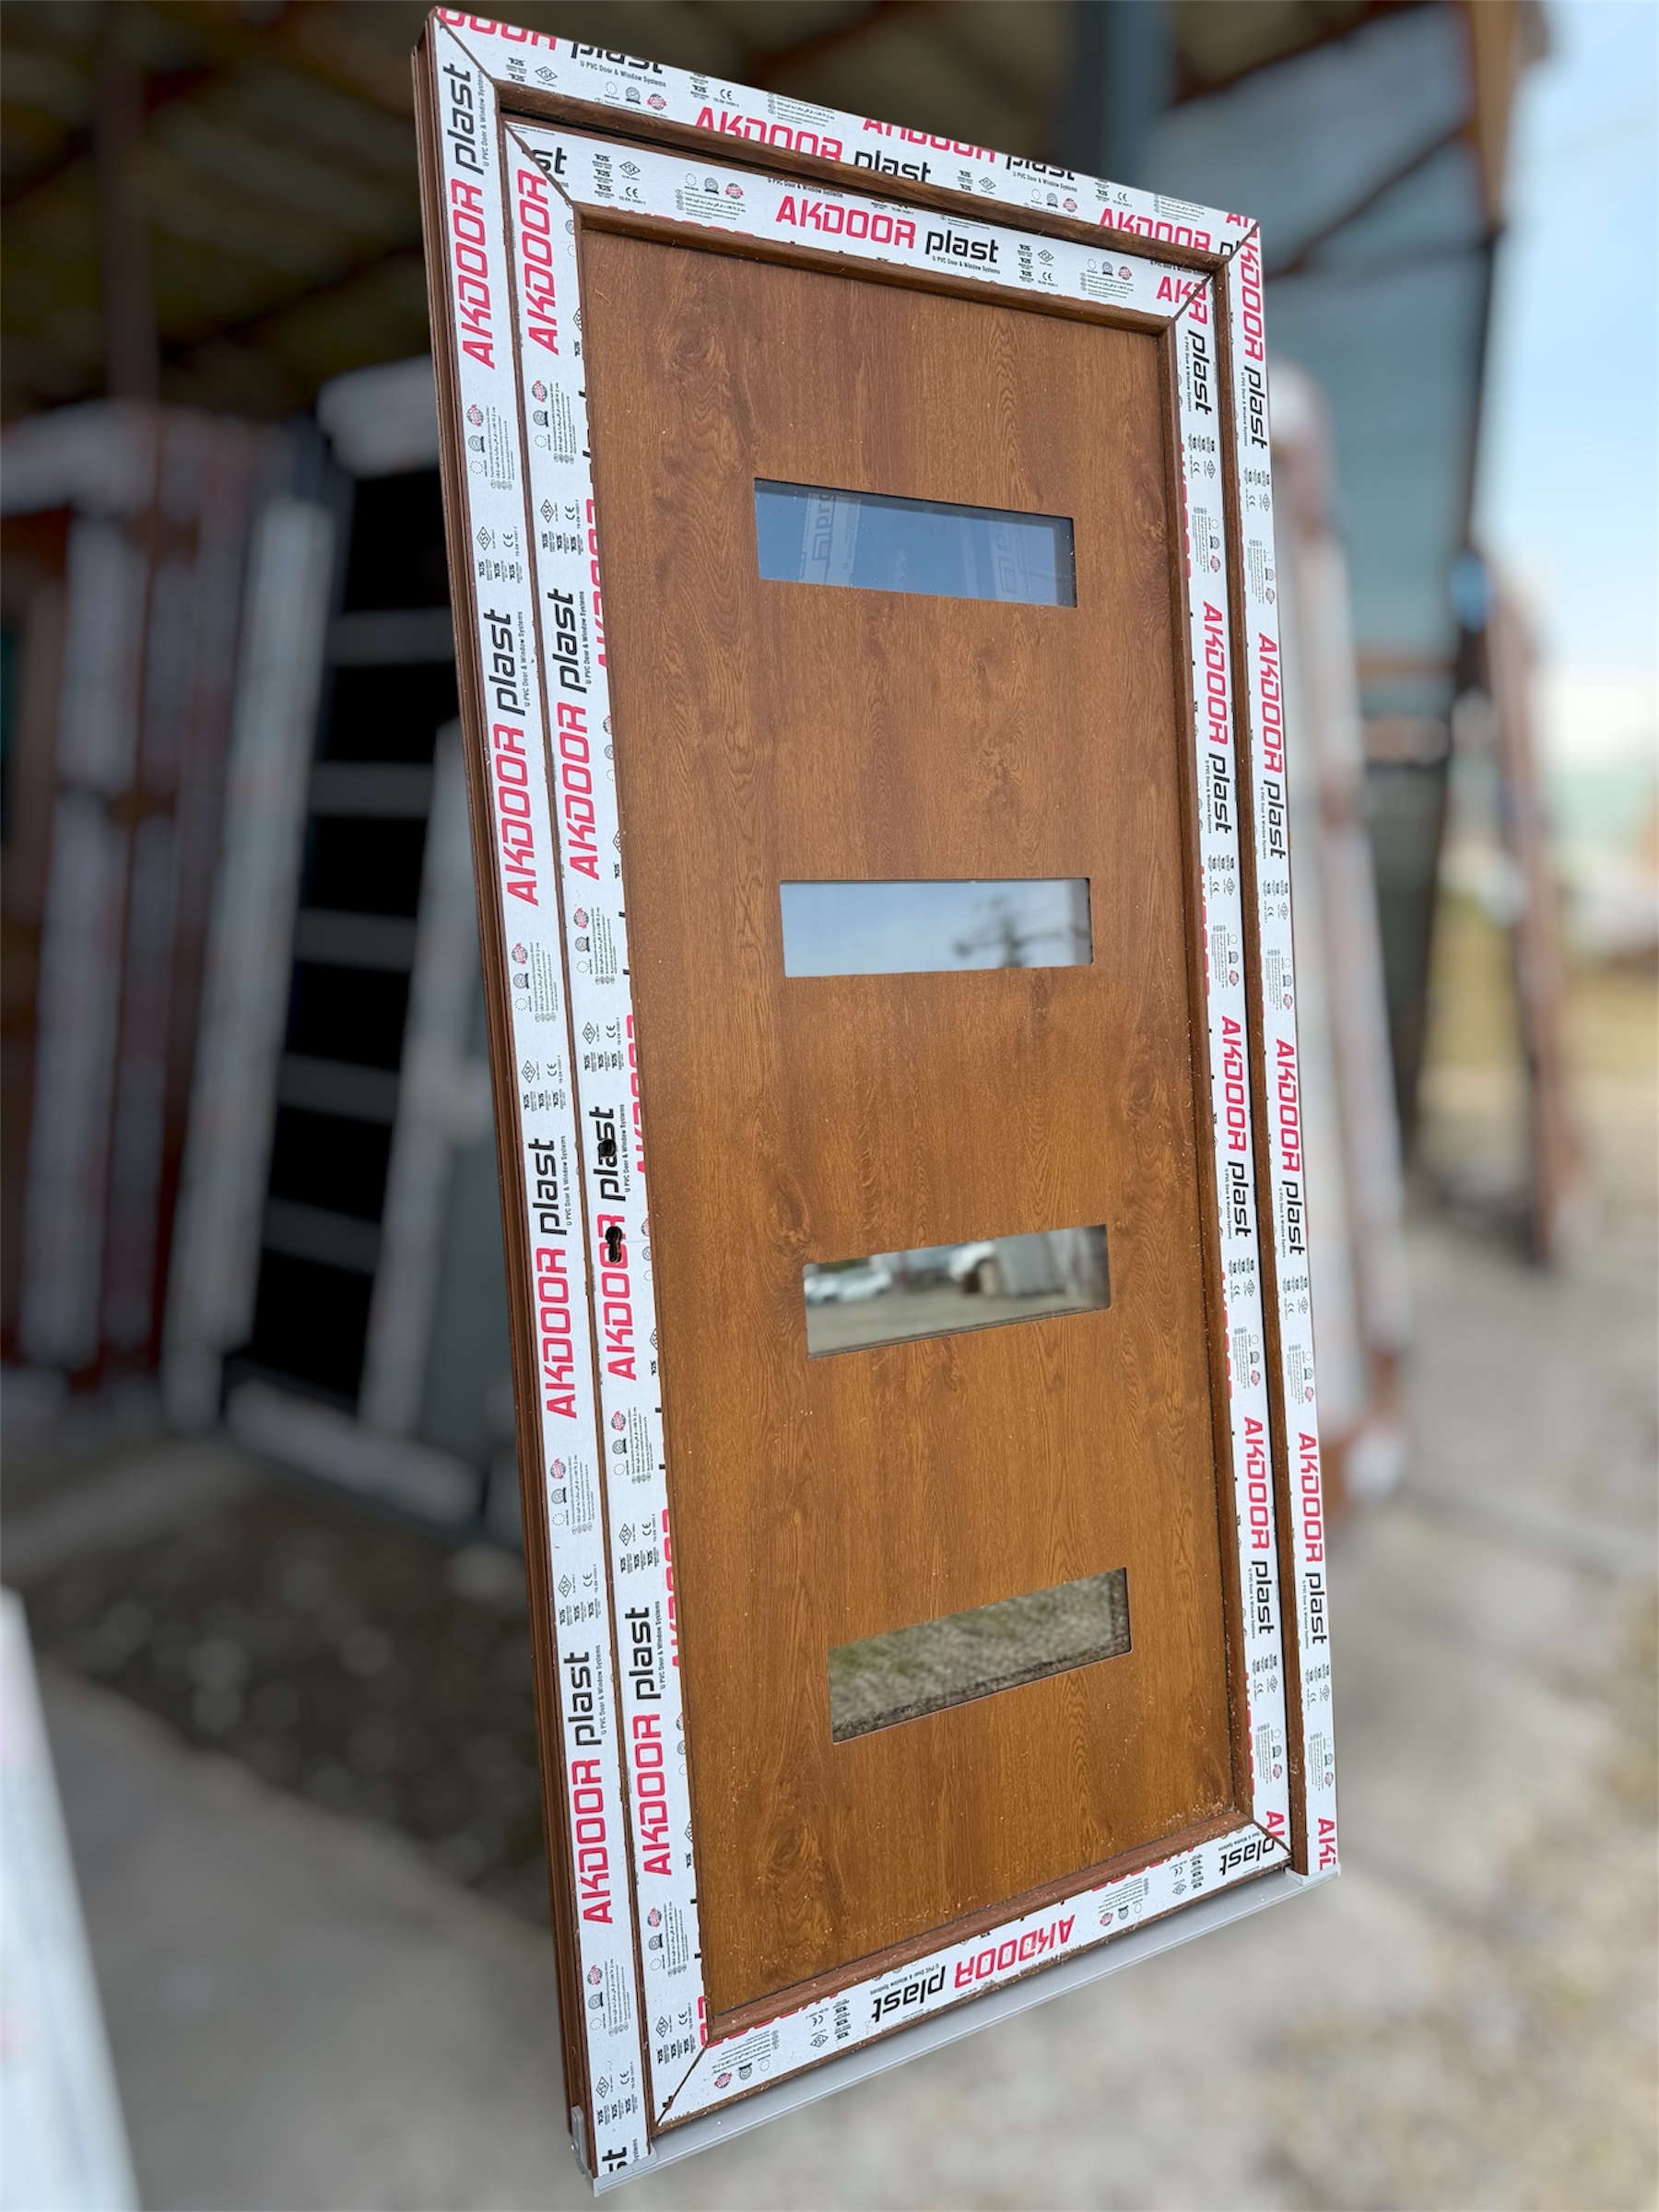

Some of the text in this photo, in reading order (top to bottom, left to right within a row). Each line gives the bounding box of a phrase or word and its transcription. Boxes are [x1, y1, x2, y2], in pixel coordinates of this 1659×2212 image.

[476, 70, 485, 96] Systems
[477, 98, 486, 122] Window
[443, 63, 495, 370] AKDOOR plast
[517, 169, 559, 355] AKDOOR
[776, 195, 916, 248] AKDOOR
[924, 230, 999, 263] plast
[1188, 329, 1212, 415] plast
[1243, 365, 1267, 449] plast
[517, 611, 525, 637] Systems
[547, 588, 587, 694] plast
[578, 591, 586, 616] Systems
[580, 618, 588, 641] Window
[483, 608, 526, 716] plast
[1203, 601, 1232, 833] AKDOOR plast
[1258, 631, 1286, 859] AKDOOR plast
[493, 723, 539, 906] AKDOOR
[557, 701, 600, 880] AKDOOR
[559, 1135, 568, 1159] Systems
[1221, 1016, 1252, 1237] AKDOOR plast
[1276, 1038, 1305, 1255] AKDOOR plast
[527, 1138, 567, 1235] plast
[535, 1247, 577, 1419] AKDOOR
[1244, 1417, 1274, 1634] AKDOOR plast
[1298, 1432, 1327, 1644] AKDOOR plast
[563, 1652, 602, 1746] plast
[625, 1607, 661, 1700] plast
[571, 1759, 613, 1924] AKDOOR
[632, 1713, 672, 1876] AKDOOR
[871, 1965, 946, 2022] plast
[954, 1914, 1076, 1988] AKDOOR
